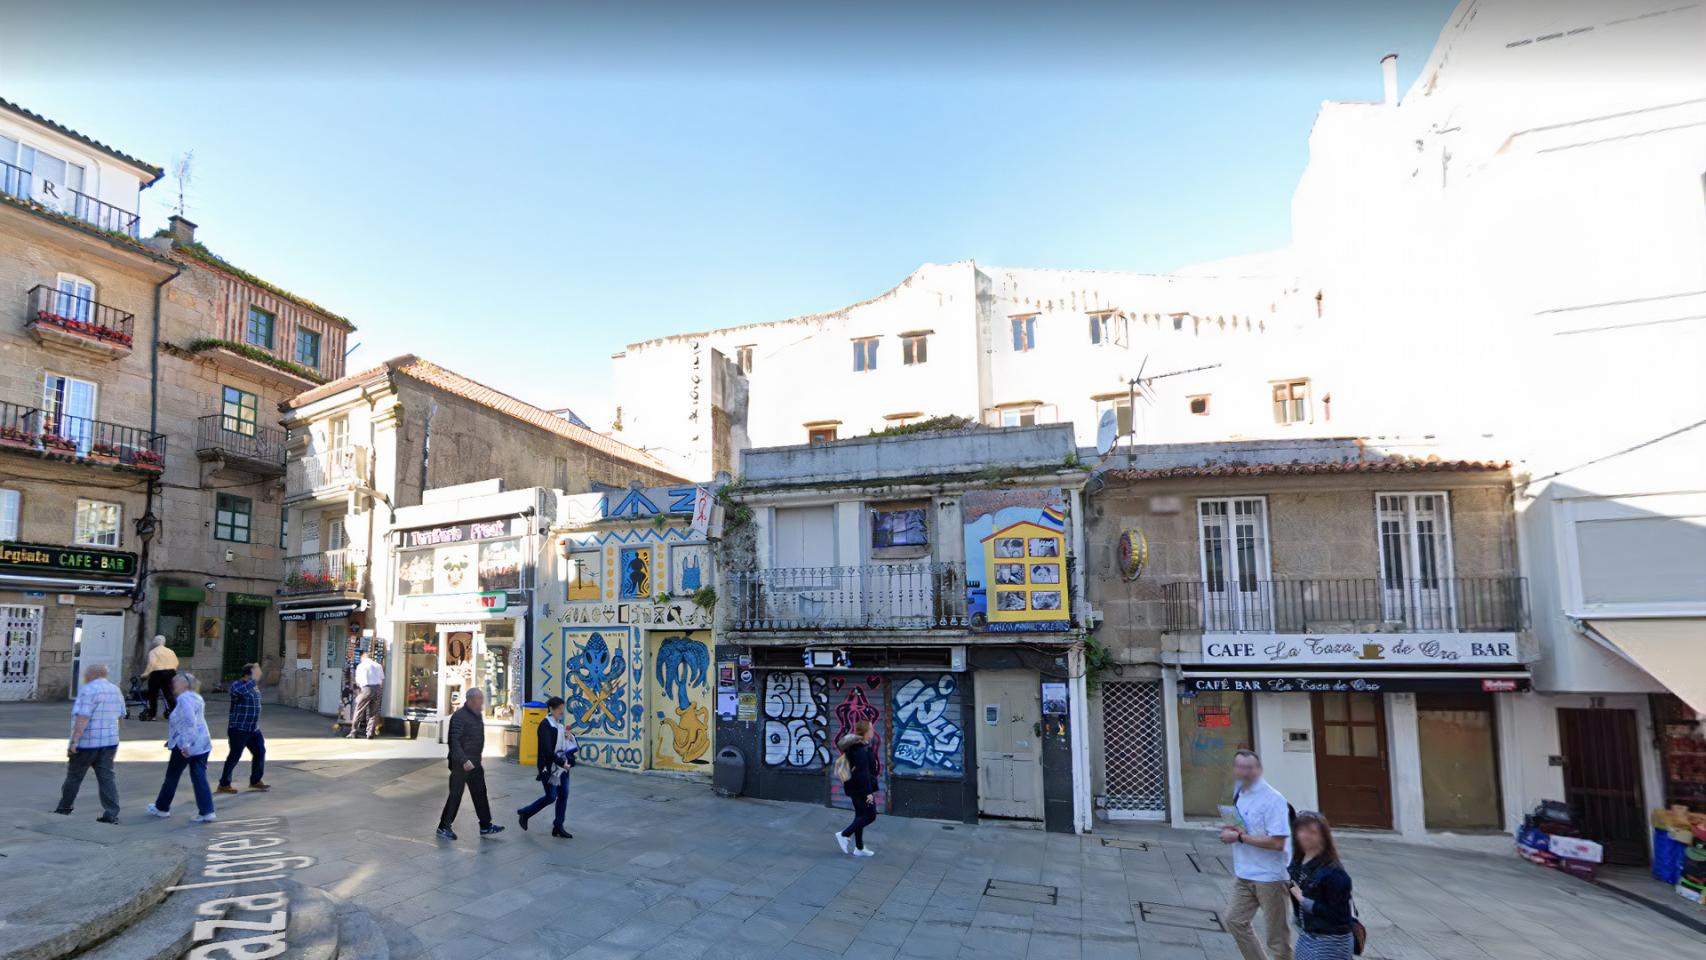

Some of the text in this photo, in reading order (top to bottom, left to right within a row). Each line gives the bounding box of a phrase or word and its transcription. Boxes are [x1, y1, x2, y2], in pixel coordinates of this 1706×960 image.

[60, 553, 91, 567] CAFE
[101, 556, 125, 570] BAR
[1207, 643, 1256, 657] CAFE
[1264, 641, 1300, 661] La
[1392, 639, 1415, 655] de
[1419, 639, 1461, 660] Oro
[1471, 643, 1512, 656] BAR
[1235, 681, 1262, 690] BAR
[1267, 678, 1293, 692] La
